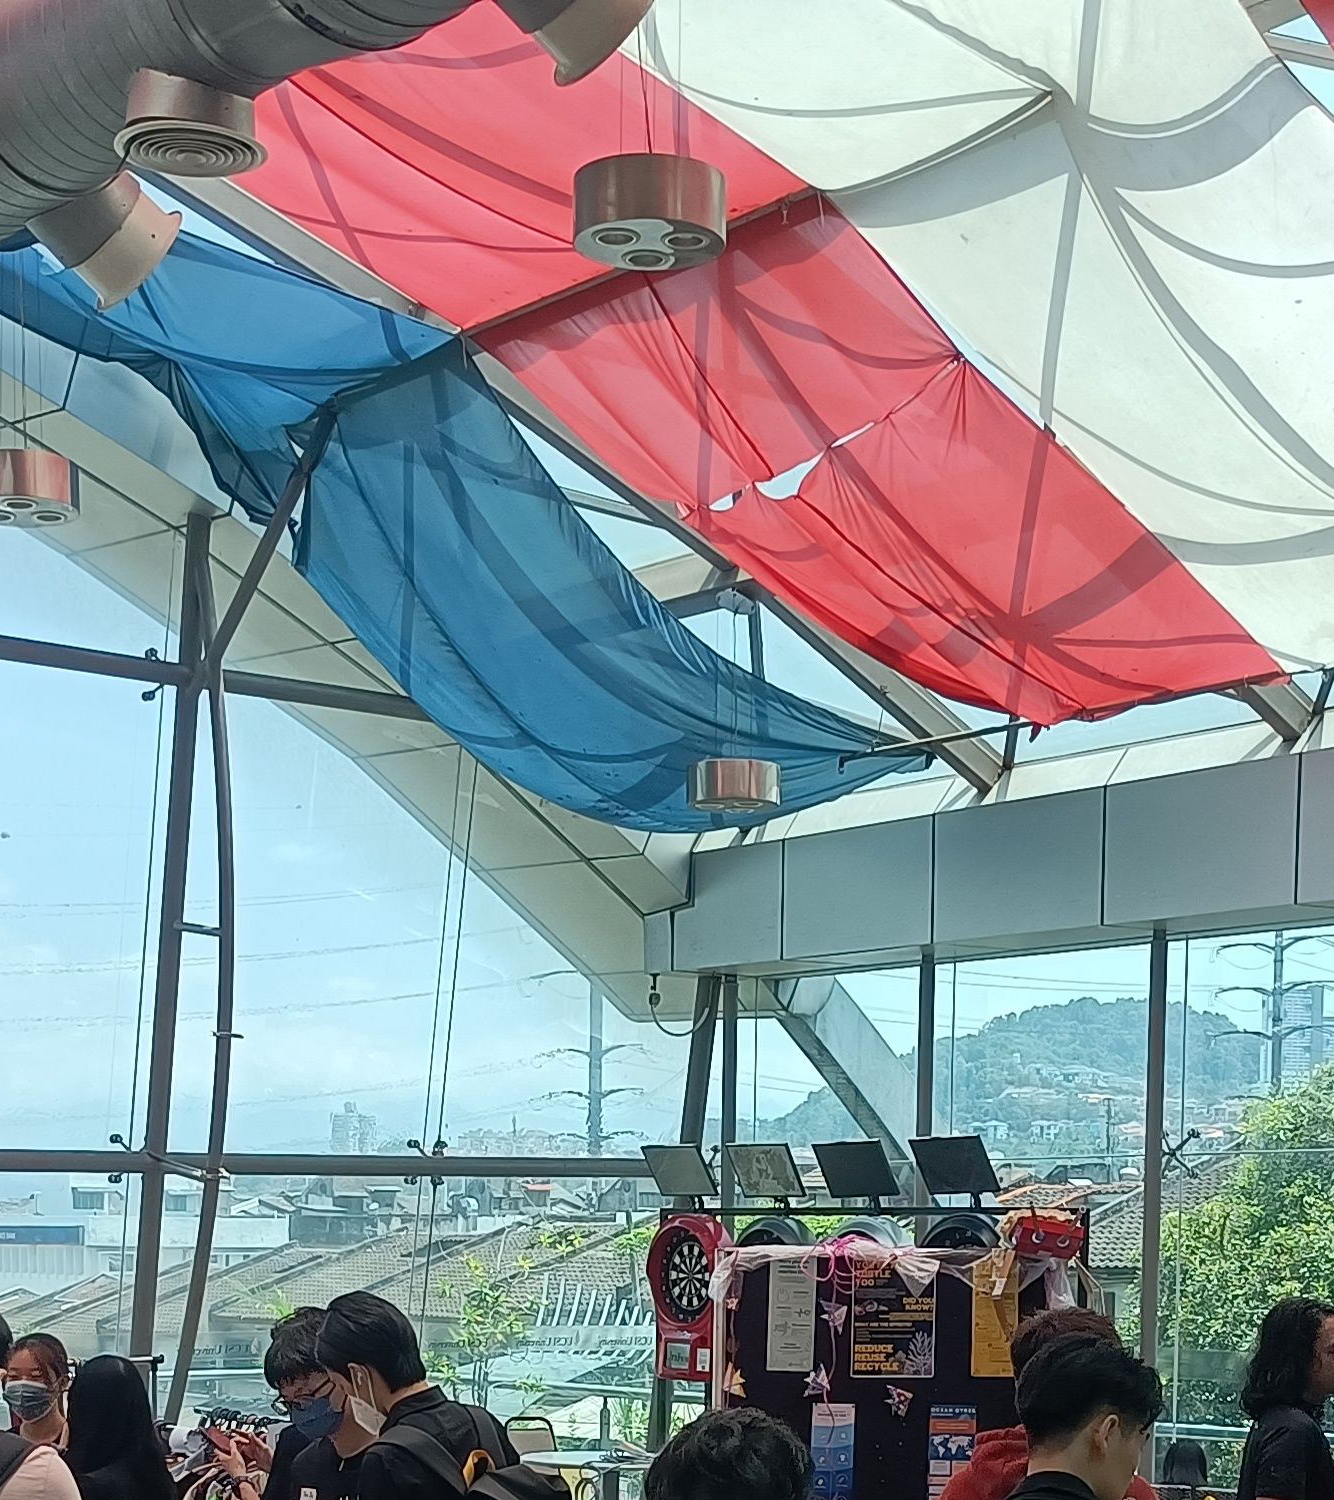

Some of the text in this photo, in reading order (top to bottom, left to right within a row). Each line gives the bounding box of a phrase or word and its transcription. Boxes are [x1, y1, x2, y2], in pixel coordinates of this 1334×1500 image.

[854, 1344, 894, 1352] REDUCE
[854, 1353, 886, 1361] REUSE
[854, 1362, 900, 1371] RECYCLE
